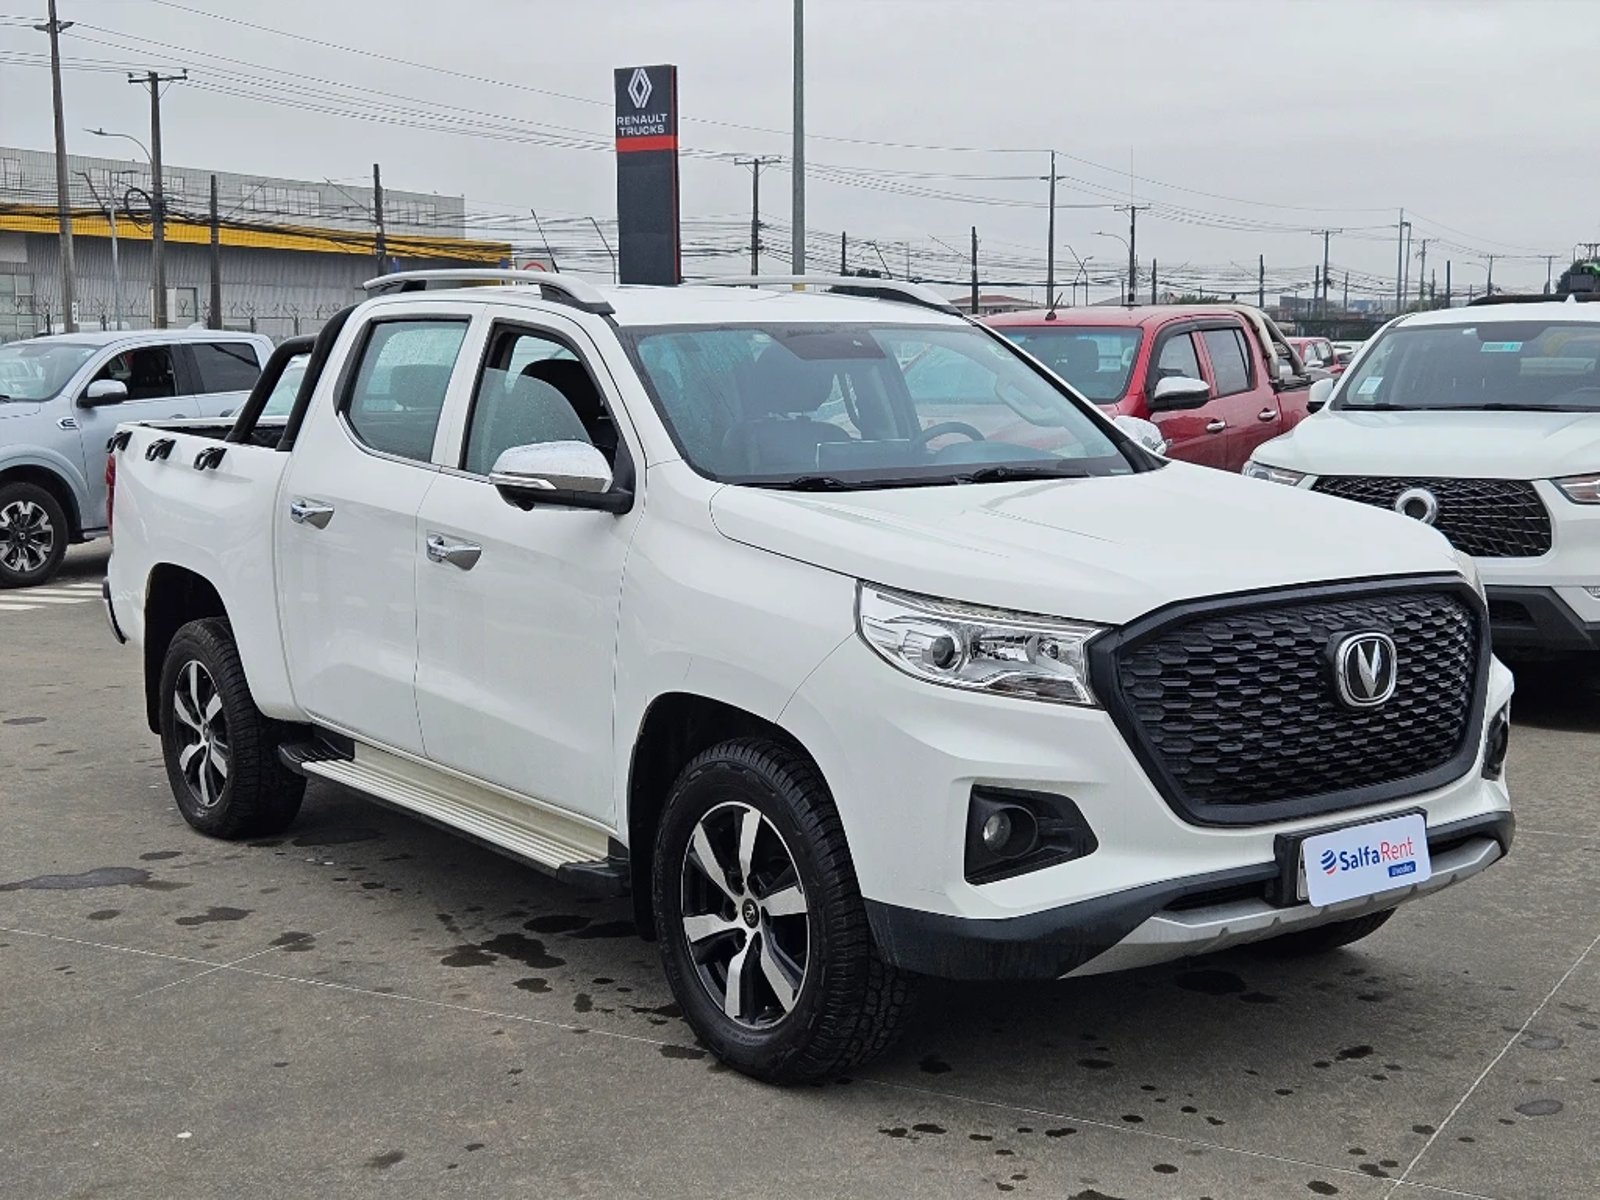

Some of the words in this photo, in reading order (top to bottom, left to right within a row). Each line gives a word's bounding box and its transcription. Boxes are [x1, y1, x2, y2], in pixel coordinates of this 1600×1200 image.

[616, 113, 668, 126] RENAULT
[620, 125, 665, 136] TRUCKS
[1339, 836, 1415, 871] SalfaRent
